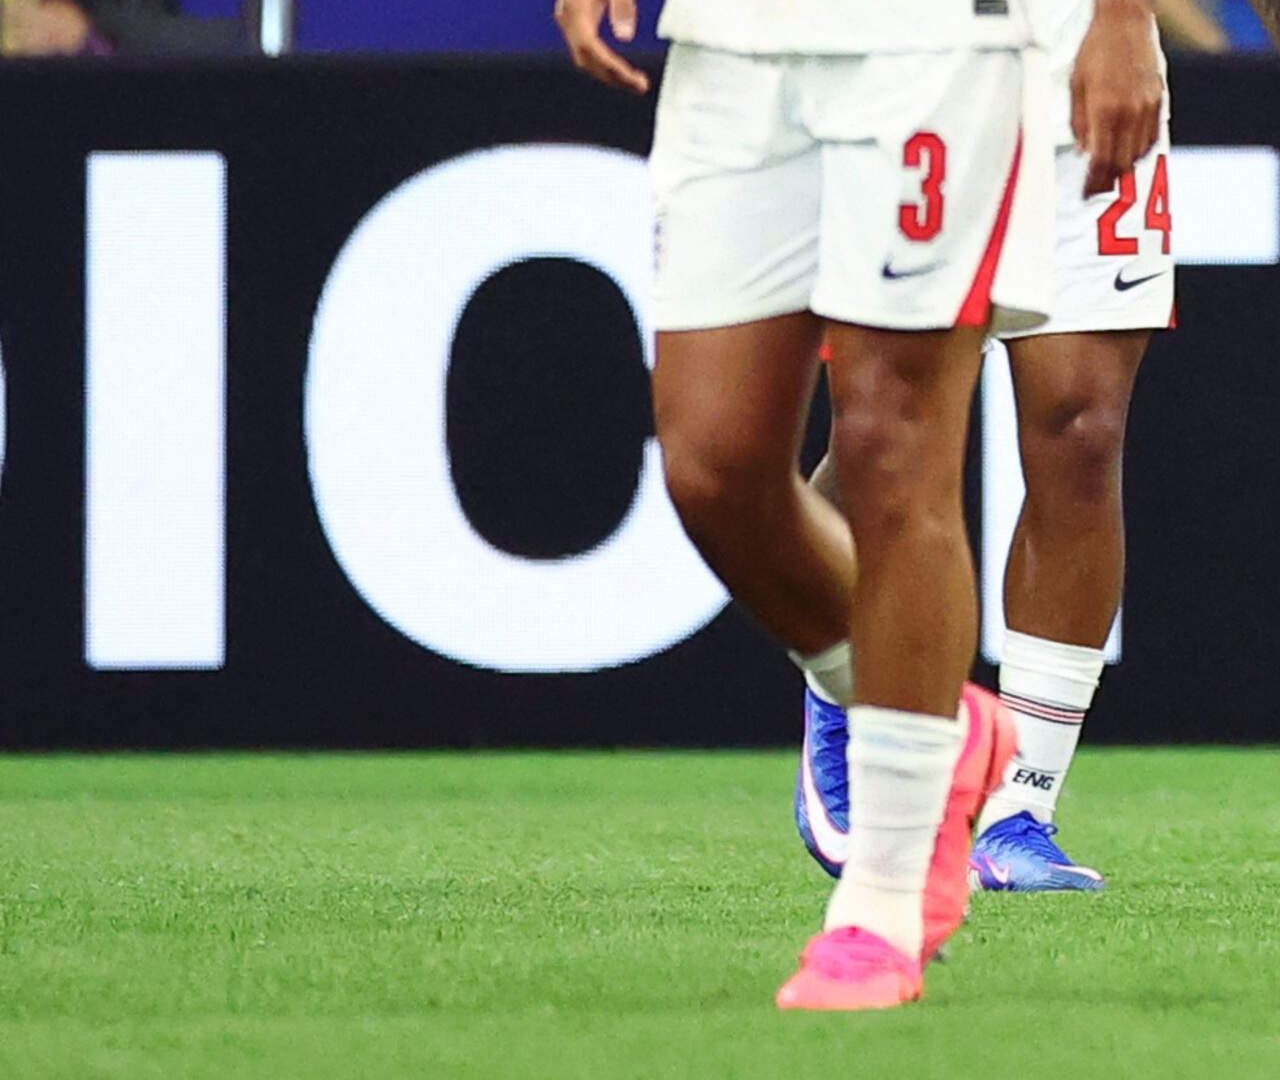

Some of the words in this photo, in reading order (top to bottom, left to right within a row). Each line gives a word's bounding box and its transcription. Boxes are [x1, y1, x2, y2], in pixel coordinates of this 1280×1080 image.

[899, 132, 946, 242] 3
[1097, 153, 1172, 255] 24
[1012, 768, 1055, 791] ENG
